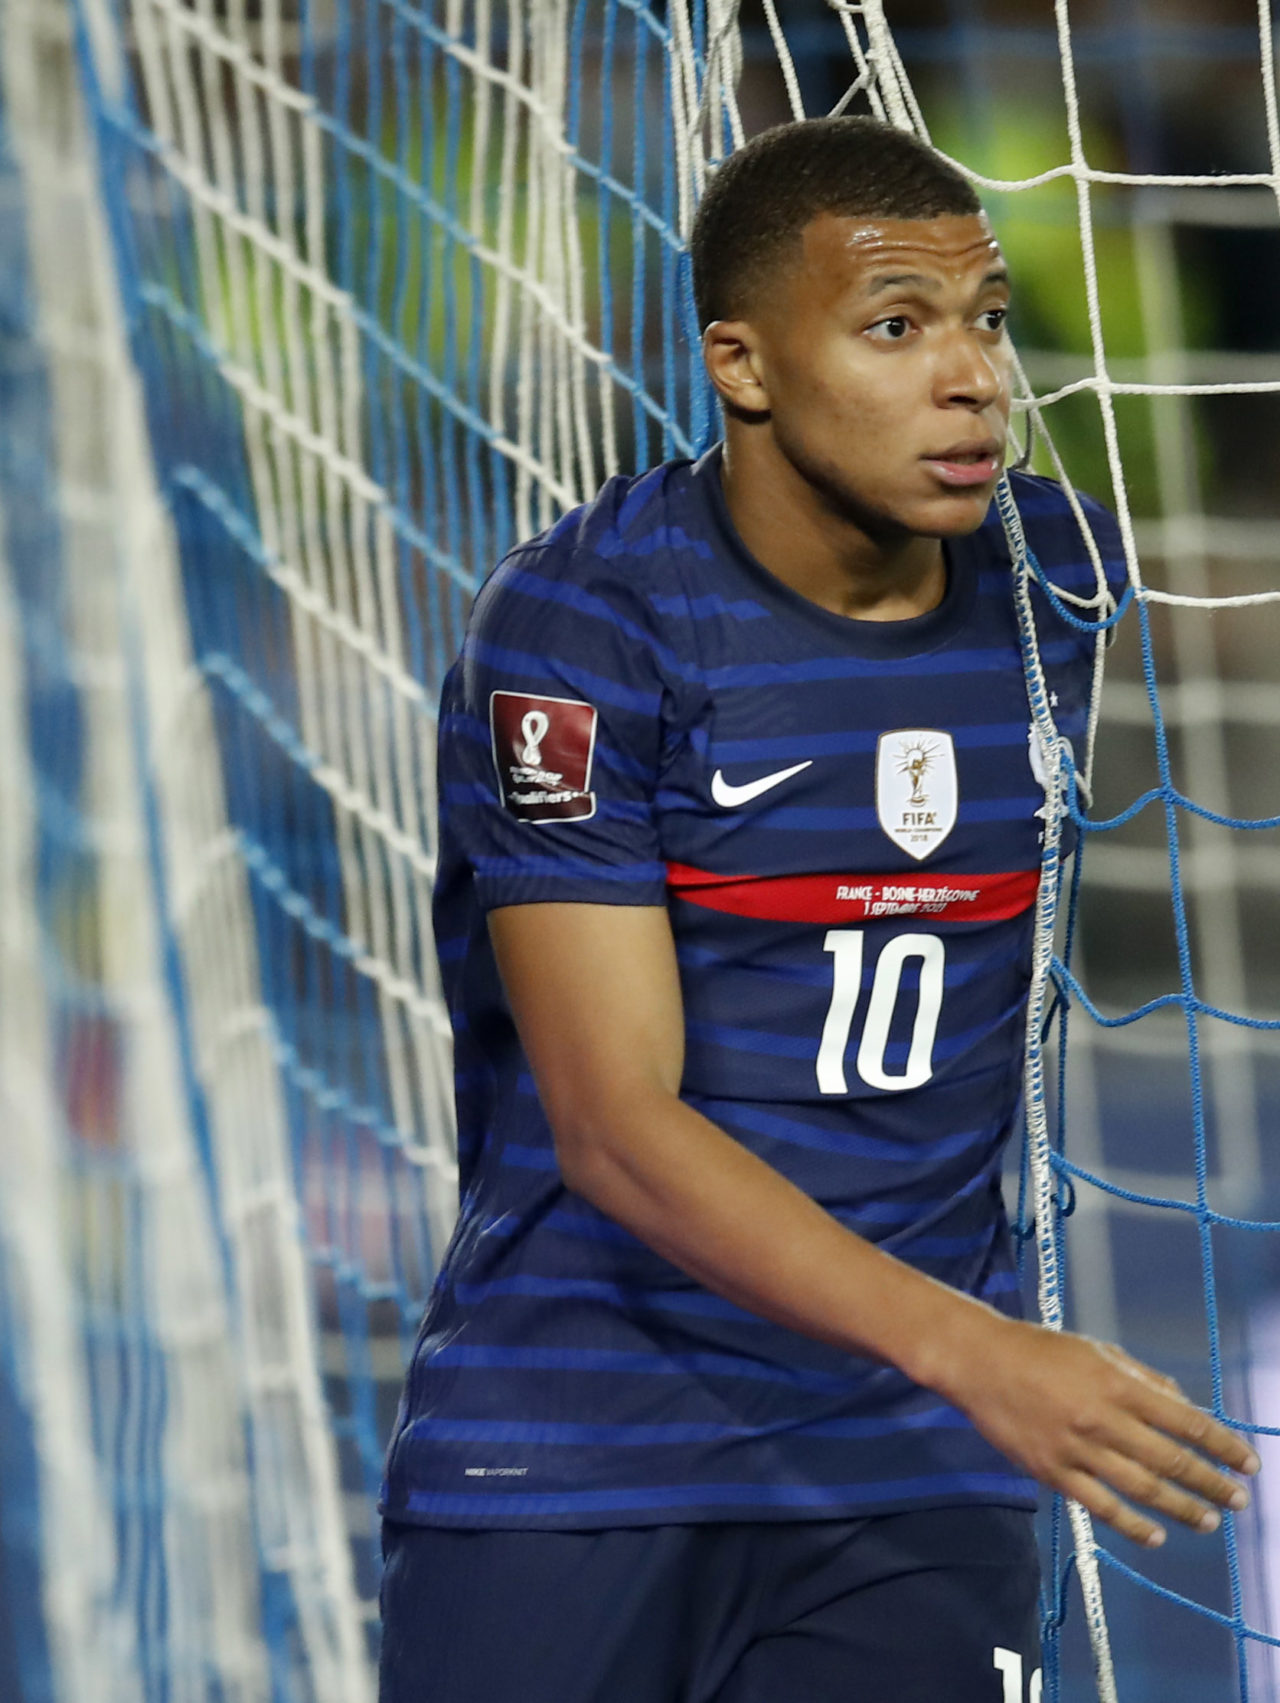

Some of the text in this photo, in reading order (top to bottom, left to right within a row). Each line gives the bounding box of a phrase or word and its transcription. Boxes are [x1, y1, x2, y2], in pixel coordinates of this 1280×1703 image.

[903, 812, 935, 825] FIFA
[836, 885, 873, 900] FRANCE
[863, 901, 869, 915] 1
[816, 929, 945, 1094] 10
[993, 1646, 1042, 1703] 1
